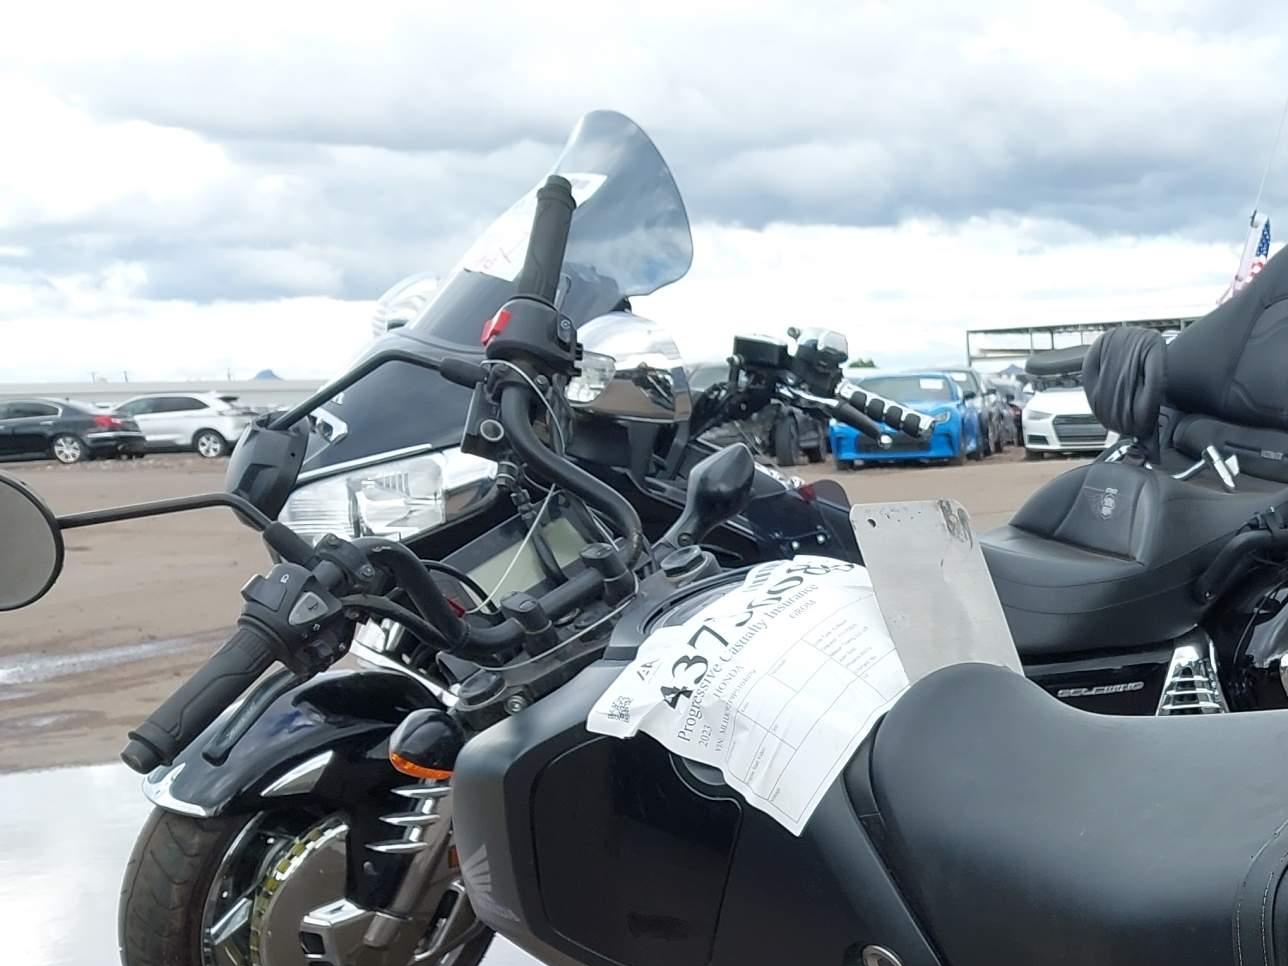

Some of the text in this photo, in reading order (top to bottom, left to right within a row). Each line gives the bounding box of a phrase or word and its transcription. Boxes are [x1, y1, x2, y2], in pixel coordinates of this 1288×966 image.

[677, 664, 722, 742] Progressive
[720, 619, 768, 663] Casualty
[764, 585, 818, 618] Insurance
[698, 724, 713, 748] 2023
[713, 665, 745, 698] HONDA
